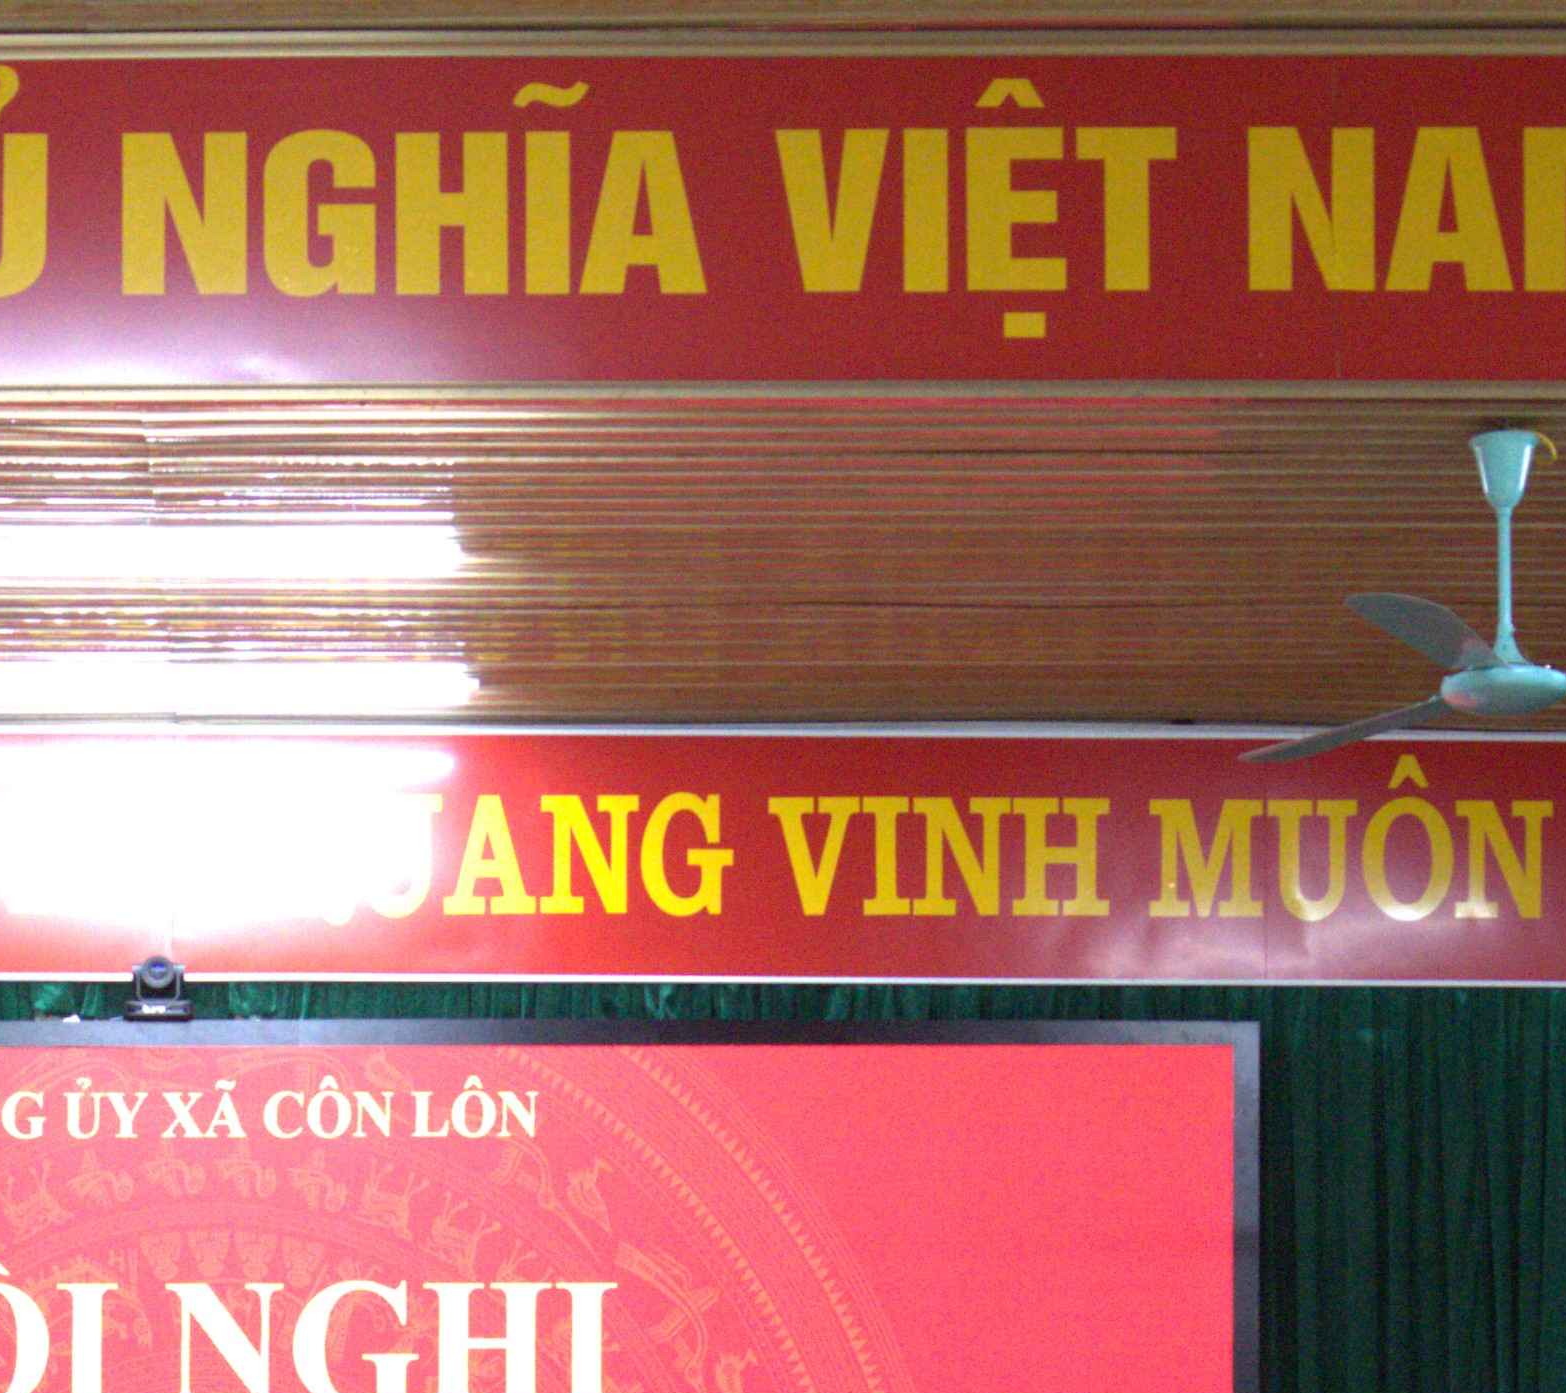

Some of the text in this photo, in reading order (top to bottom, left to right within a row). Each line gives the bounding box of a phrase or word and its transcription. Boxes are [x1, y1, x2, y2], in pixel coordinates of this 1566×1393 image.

[120, 82, 708, 297] NGHĨA
[775, 78, 1178, 338] VIỆT
[767, 795, 1111, 917] VINH
[1148, 754, 1554, 922] MUÔN
[63, 1076, 150, 1140] ỦY
[160, 1080, 247, 1139] XÃ
[262, 1075, 395, 1140] CÔN
[412, 1074, 539, 1139] LÔN
